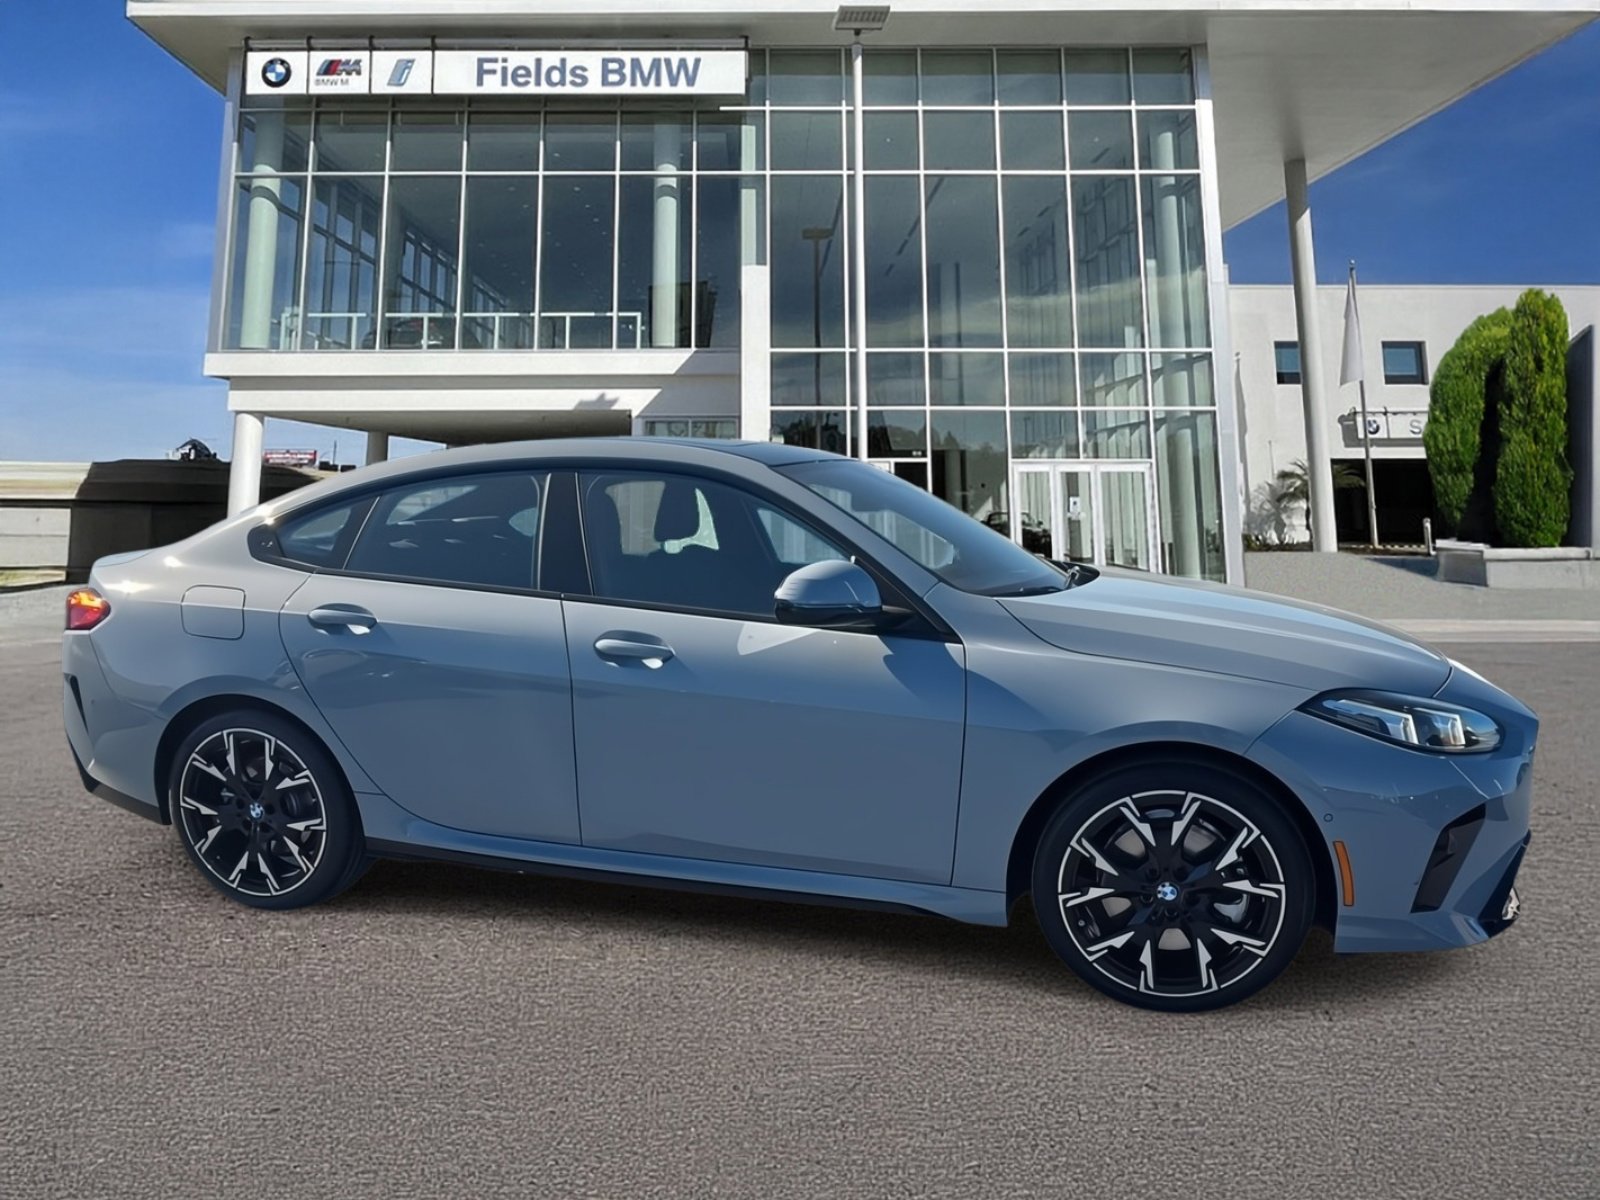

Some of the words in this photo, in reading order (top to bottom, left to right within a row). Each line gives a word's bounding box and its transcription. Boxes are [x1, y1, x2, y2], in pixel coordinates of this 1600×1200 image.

[476, 57, 589, 87] Fields
[601, 57, 702, 87] BMW
[314, 78, 338, 86] BMW
